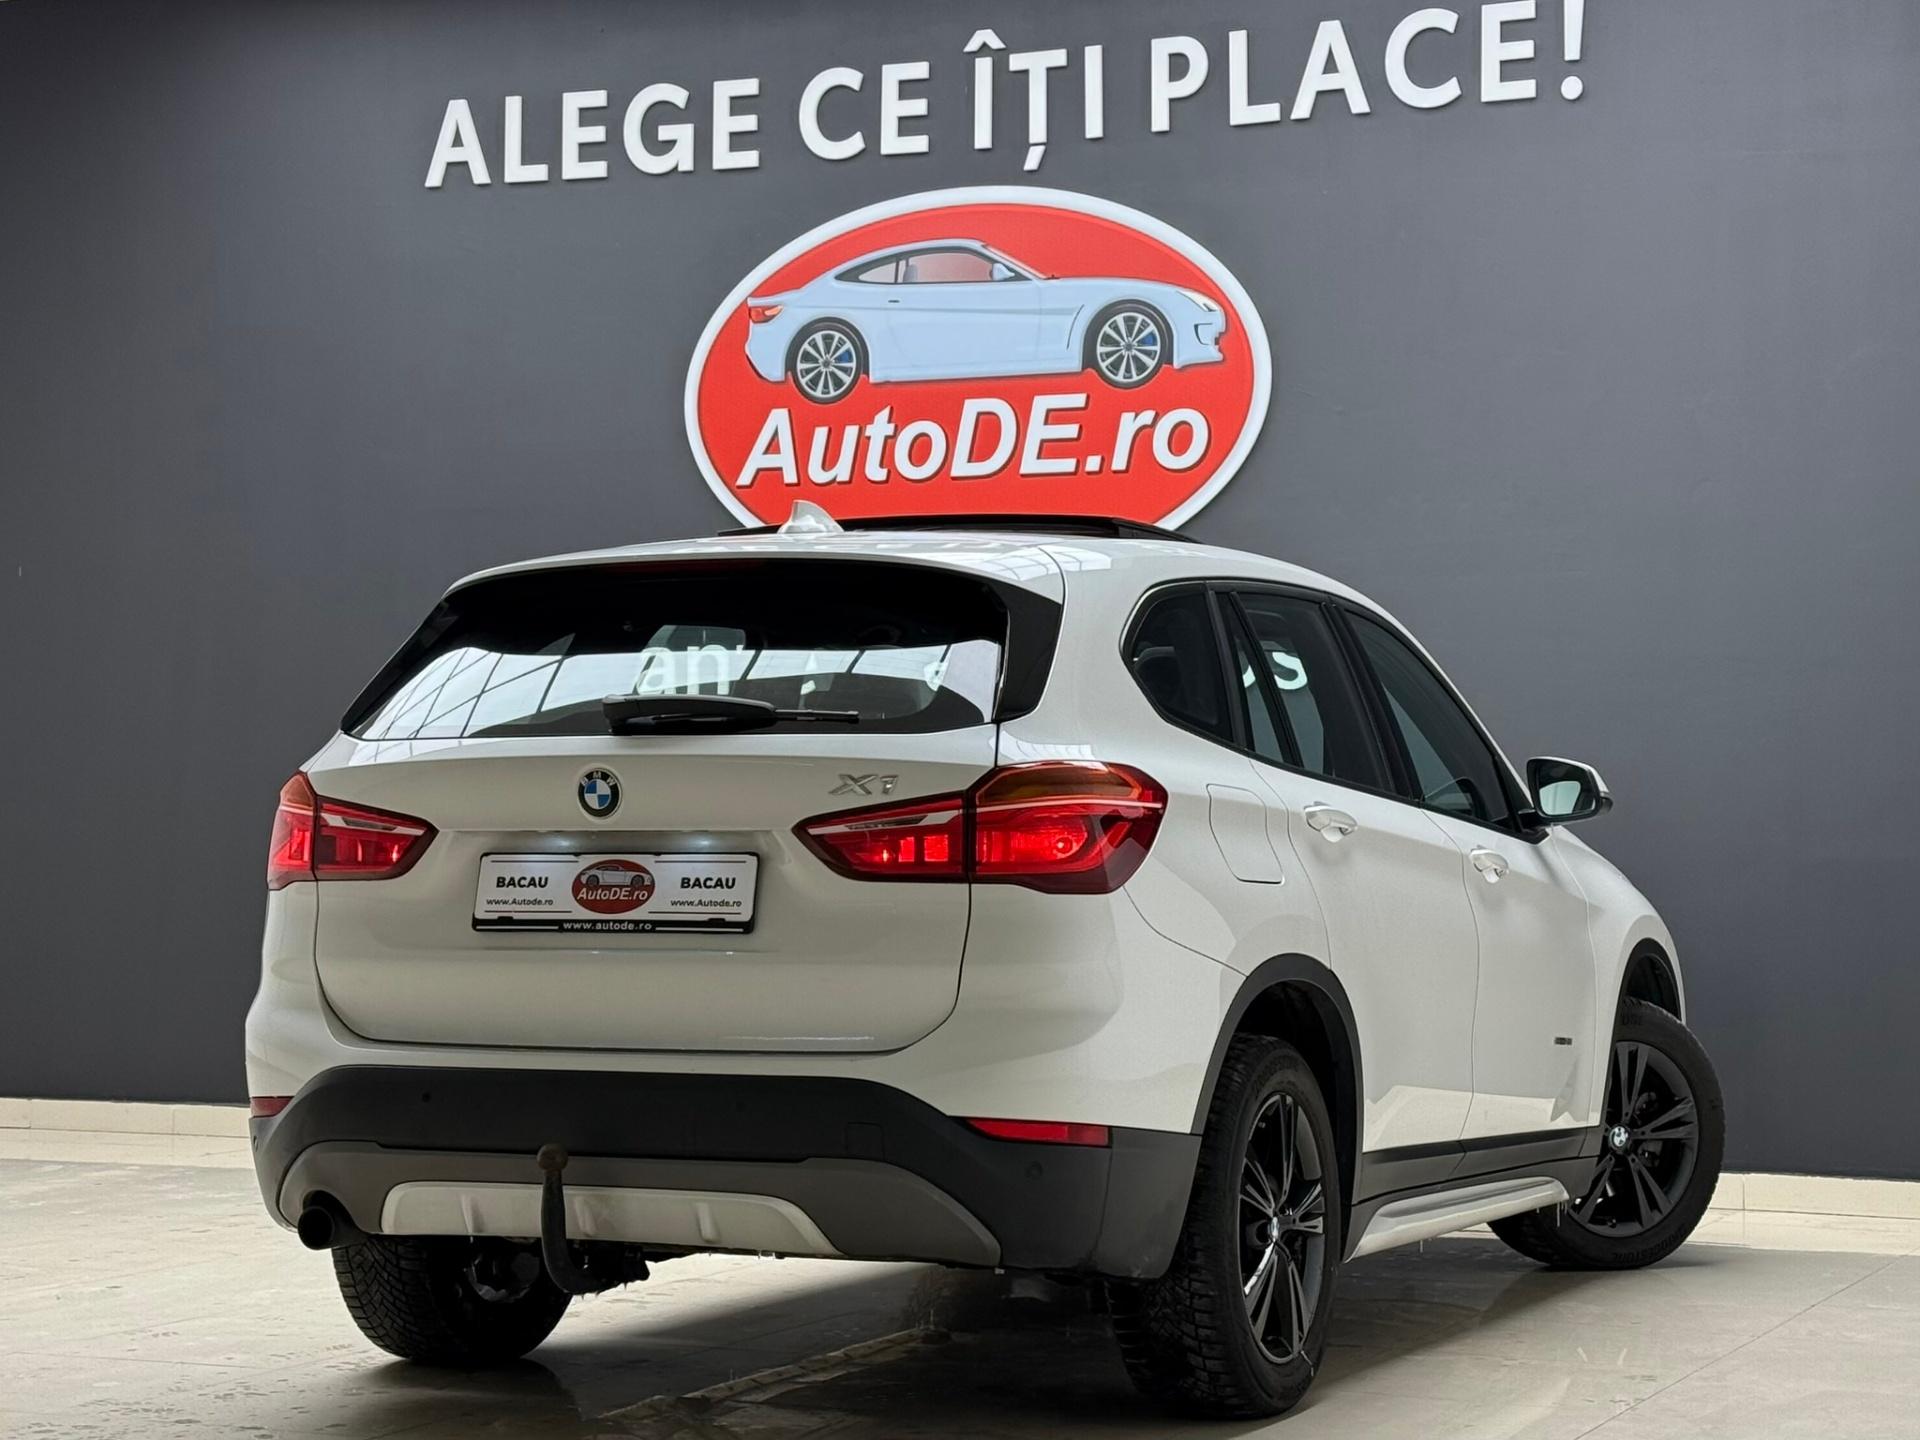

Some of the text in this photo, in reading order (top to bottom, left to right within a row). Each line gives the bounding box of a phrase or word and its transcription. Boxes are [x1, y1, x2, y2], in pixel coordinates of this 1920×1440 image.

[424, 0, 1586, 188] ALEGE CE ÎȚI PLACE!
[735, 394, 1210, 488] AutoDE.ro
[580, 771, 617, 786] BMW
[828, 773, 899, 795] X1
[495, 876, 549, 889] BACAU
[680, 877, 736, 890] BACAU
[576, 887, 648, 902] AutoDE.ro
[486, 897, 554, 907] www.Autode.ro
[670, 898, 743, 908] www.Autode.ro
[562, 920, 653, 932] www.autode.ro
